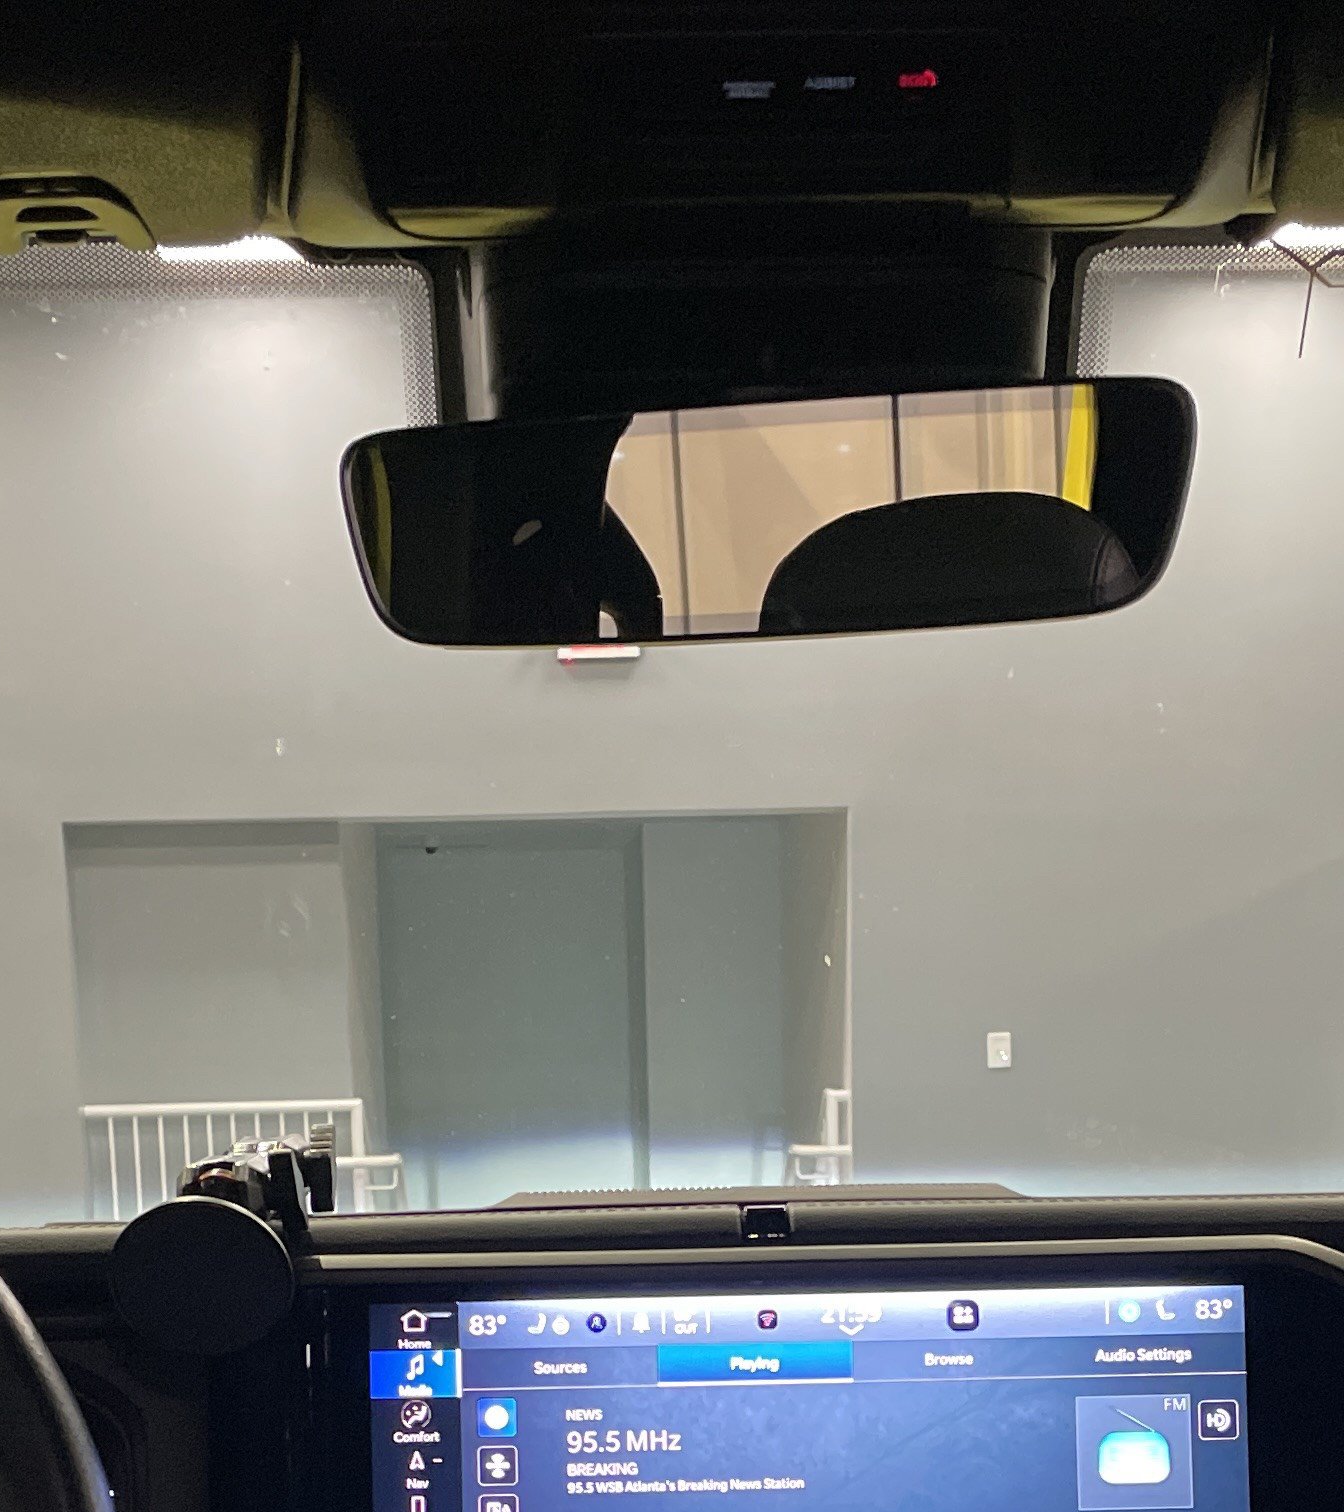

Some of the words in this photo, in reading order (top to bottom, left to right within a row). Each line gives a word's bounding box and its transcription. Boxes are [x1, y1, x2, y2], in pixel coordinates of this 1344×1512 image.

[1194, 1298, 1234, 1321] 83°
[468, 1313, 507, 1337] 83°
[398, 1339, 432, 1350] Home
[924, 1350, 974, 1368] Browse
[1094, 1347, 1136, 1364] Audio
[1137, 1345, 1193, 1365] Settings
[533, 1359, 588, 1376] Sources
[729, 1355, 780, 1374] Playing
[1163, 1396, 1188, 1412] FM
[565, 1408, 604, 1422] NEWS
[393, 1430, 441, 1444] Comfort
[566, 1429, 622, 1454] 95.5
[625, 1429, 683, 1452] MHz
[566, 1462, 639, 1477] BREAKING
[406, 1478, 430, 1490] Nav
[567, 1481, 595, 1495] 95.5
[595, 1480, 624, 1494] WSB
[624, 1479, 677, 1493] Atlanta's
[677, 1478, 729, 1493] Breaking
[729, 1478, 764, 1491] News
[764, 1476, 806, 1490] Station
